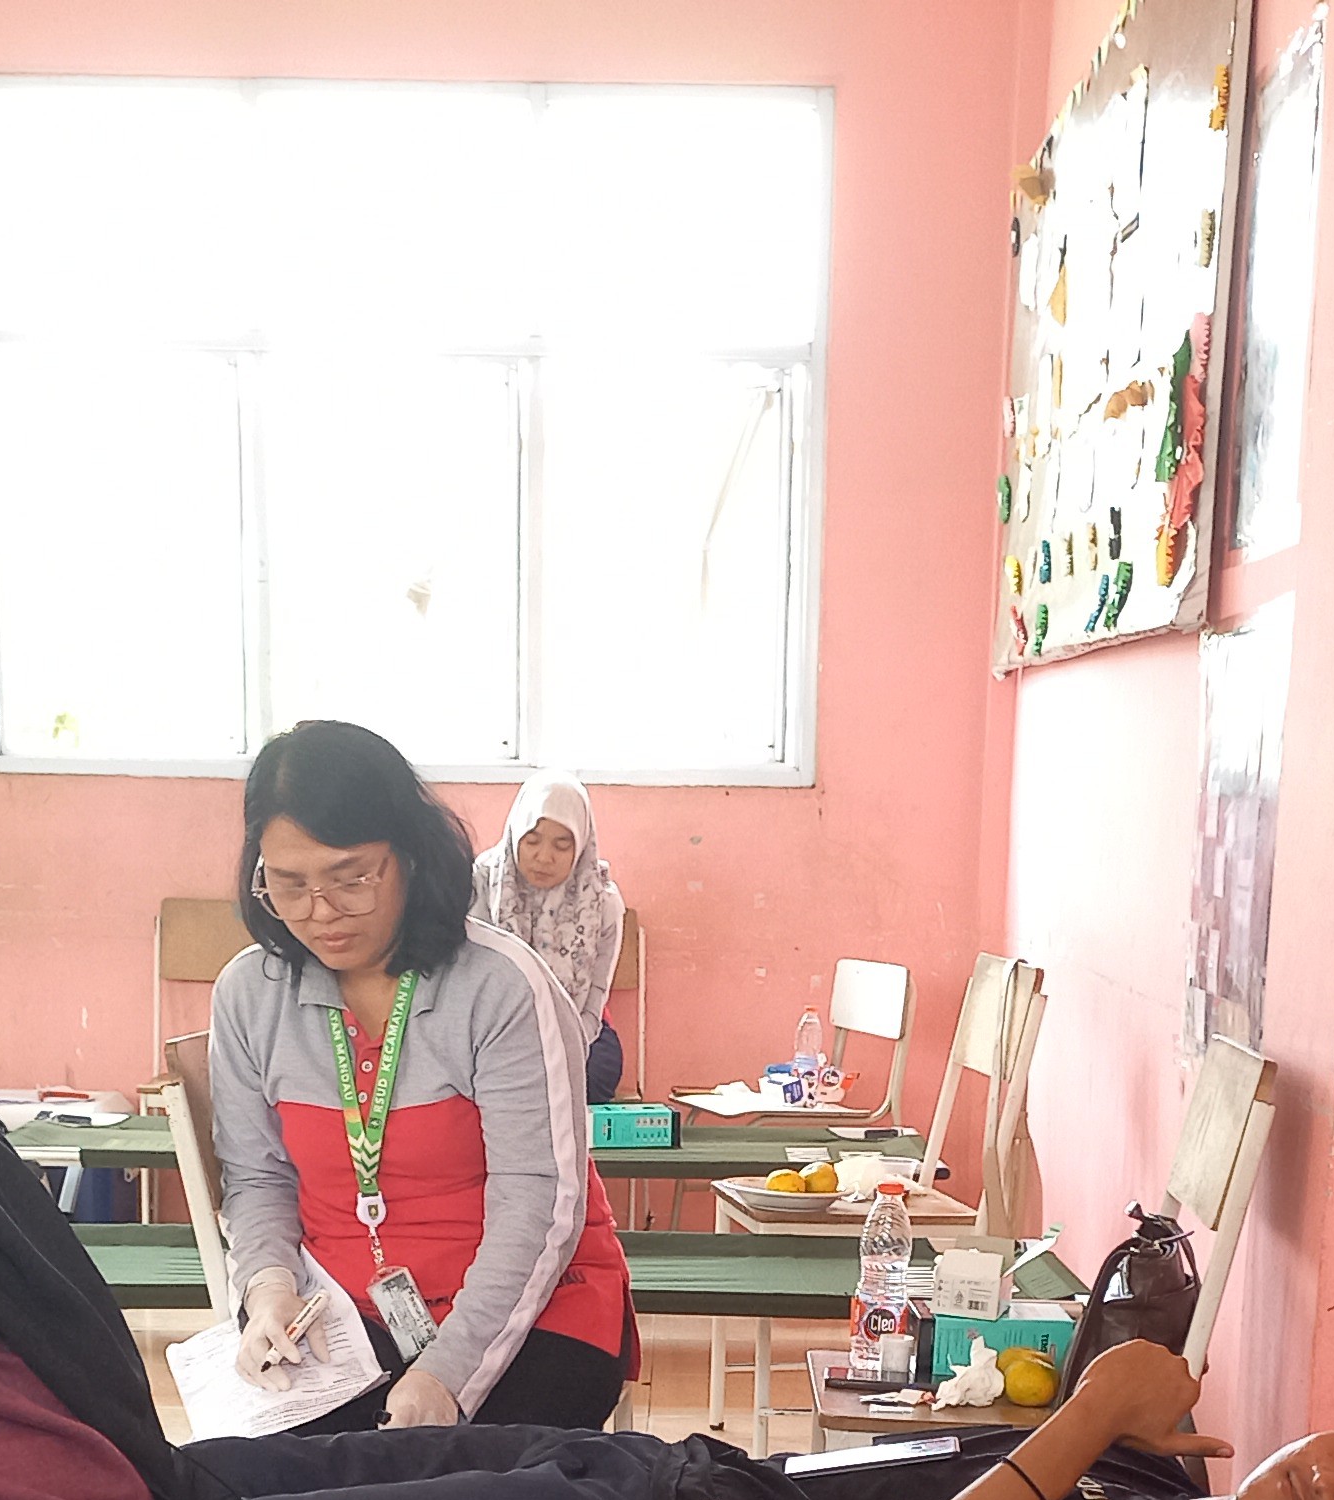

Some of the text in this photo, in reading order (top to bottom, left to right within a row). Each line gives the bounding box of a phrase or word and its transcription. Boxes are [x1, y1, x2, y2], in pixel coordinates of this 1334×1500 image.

[336, 1043, 354, 1101] MANDAU
[373, 1078, 387, 1113] RSUD
[381, 991, 408, 1072] KECAMATAN
[870, 1314, 895, 1332] Cleo
